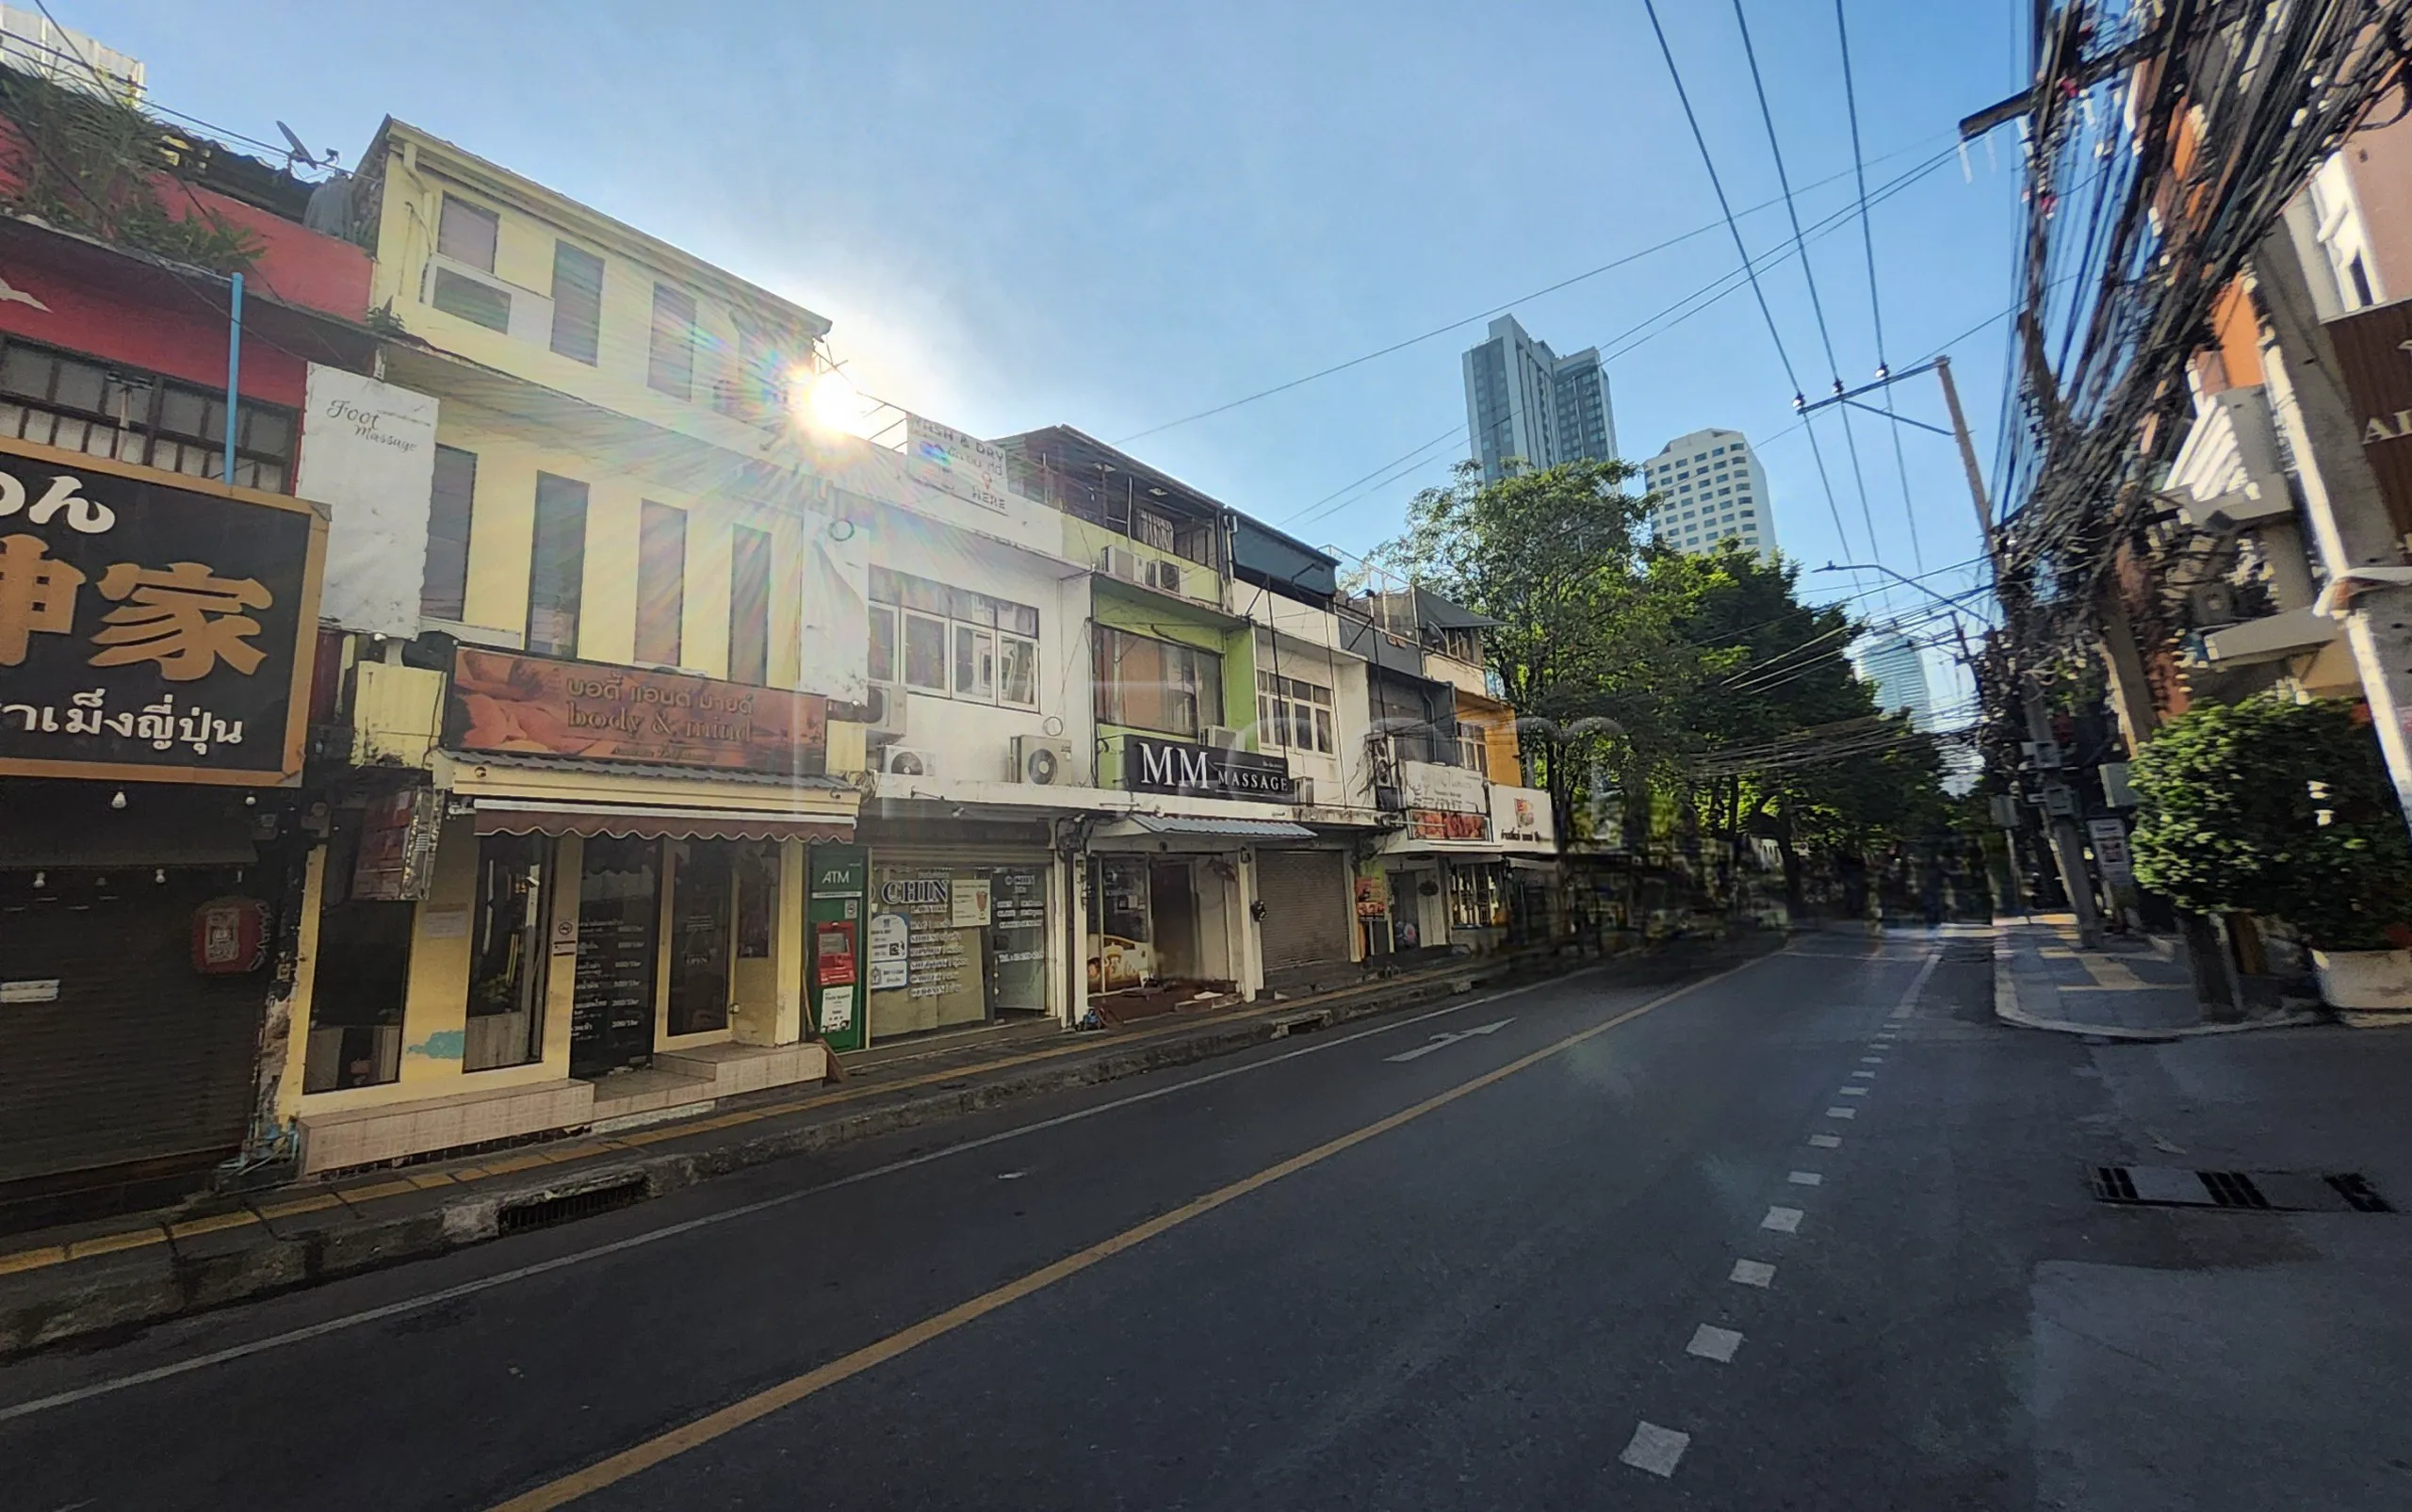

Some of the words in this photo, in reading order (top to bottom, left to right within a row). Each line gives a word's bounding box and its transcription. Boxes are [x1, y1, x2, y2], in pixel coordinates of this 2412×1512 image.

[327, 399, 379, 430] Foot
[976, 442, 1003, 463] DRY
[972, 487, 1005, 510] HERE
[0, 689, 242, 755] าเม็งญี่ปุ่น
[567, 701, 647, 740] body
[651, 713, 677, 738] &
[687, 718, 755, 745] mind
[1138, 742, 1211, 789] MM
[1217, 770, 1289, 792] MASSAGE
[822, 870, 850, 884] ATM
[882, 879, 950, 904] CHIN
